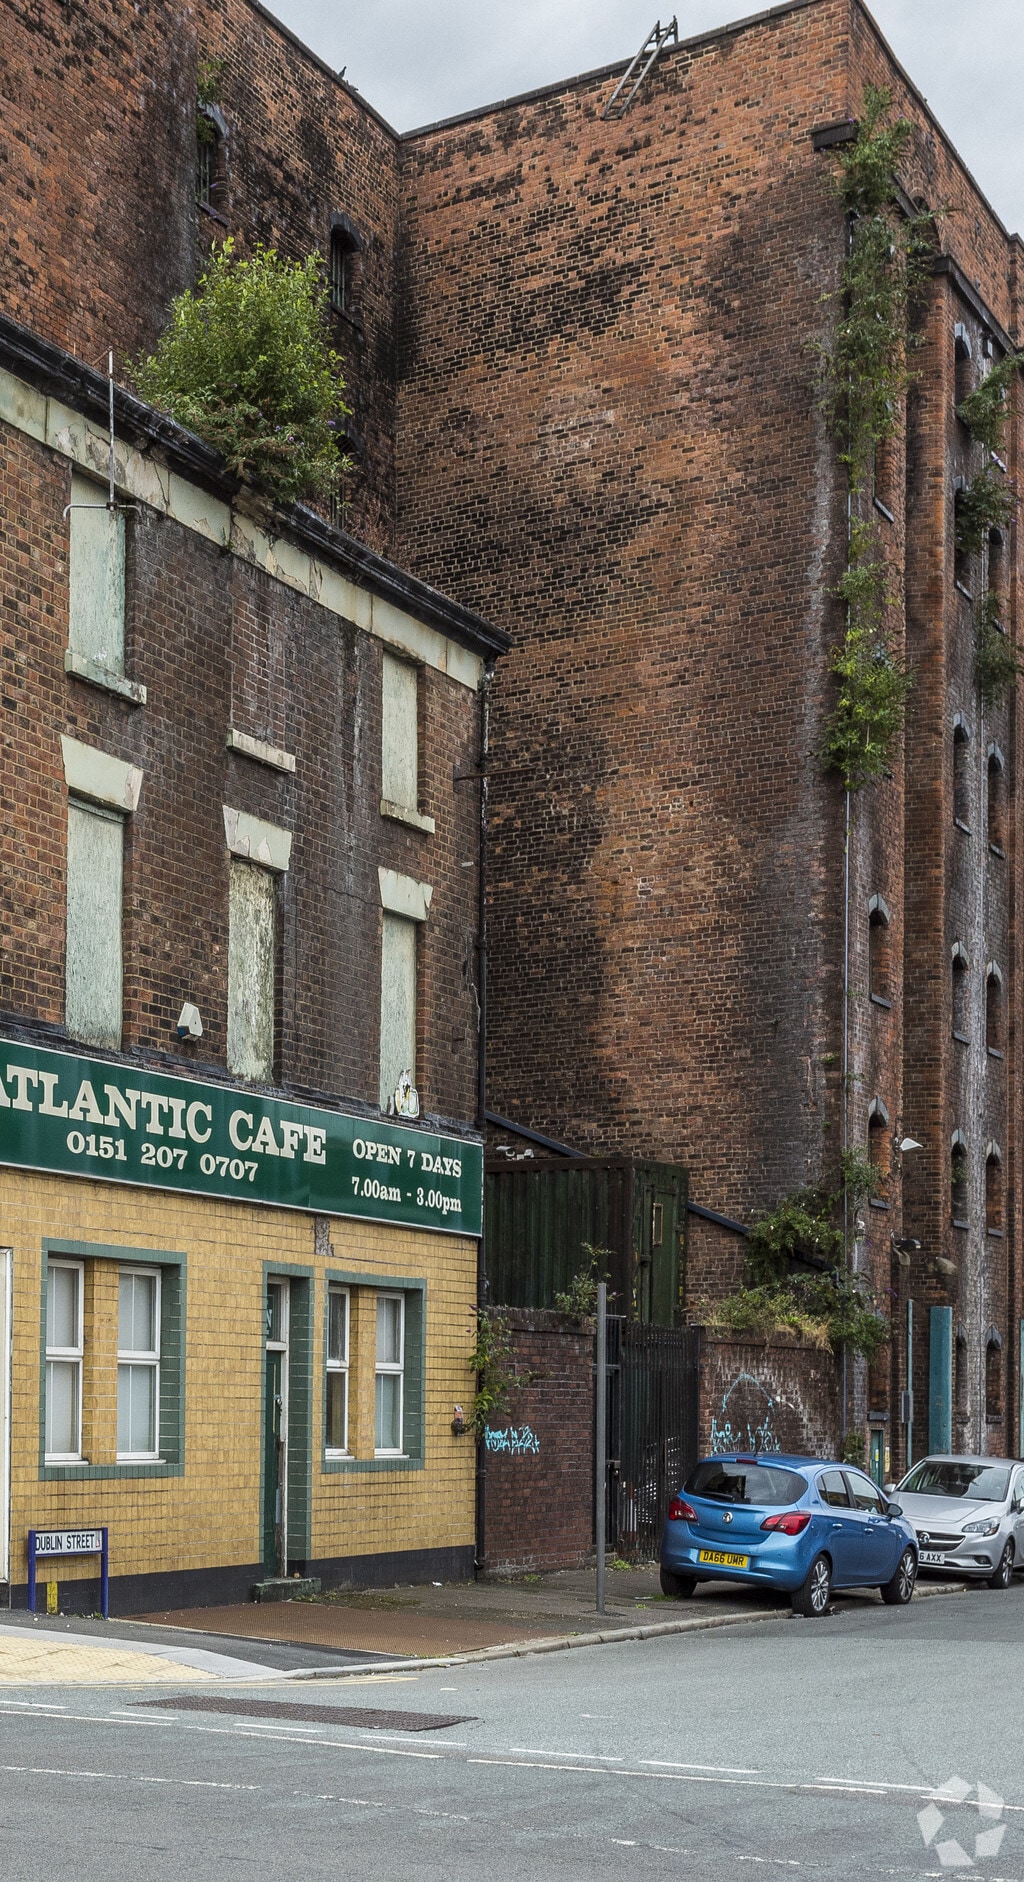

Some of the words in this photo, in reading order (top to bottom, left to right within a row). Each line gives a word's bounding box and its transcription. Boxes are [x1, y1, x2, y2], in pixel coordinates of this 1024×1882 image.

[66, 1130, 128, 1162] 0151
[140, 1142, 189, 1172] 207
[199, 1153, 259, 1183] 0707
[228, 1109, 326, 1166] CAFE
[352, 1138, 401, 1166] OPEN
[407, 1151, 417, 1169] 7
[421, 1151, 463, 1178] DAYS
[351, 1176, 402, 1204] 7.00am
[417, 1187, 462, 1215] 3.00pm
[35, 1535, 63, 1551] DUBLIN
[66, 1533, 95, 1550] STREET
[702, 1551, 726, 1564] DA66
[926, 1552, 942, 1562] AXX
